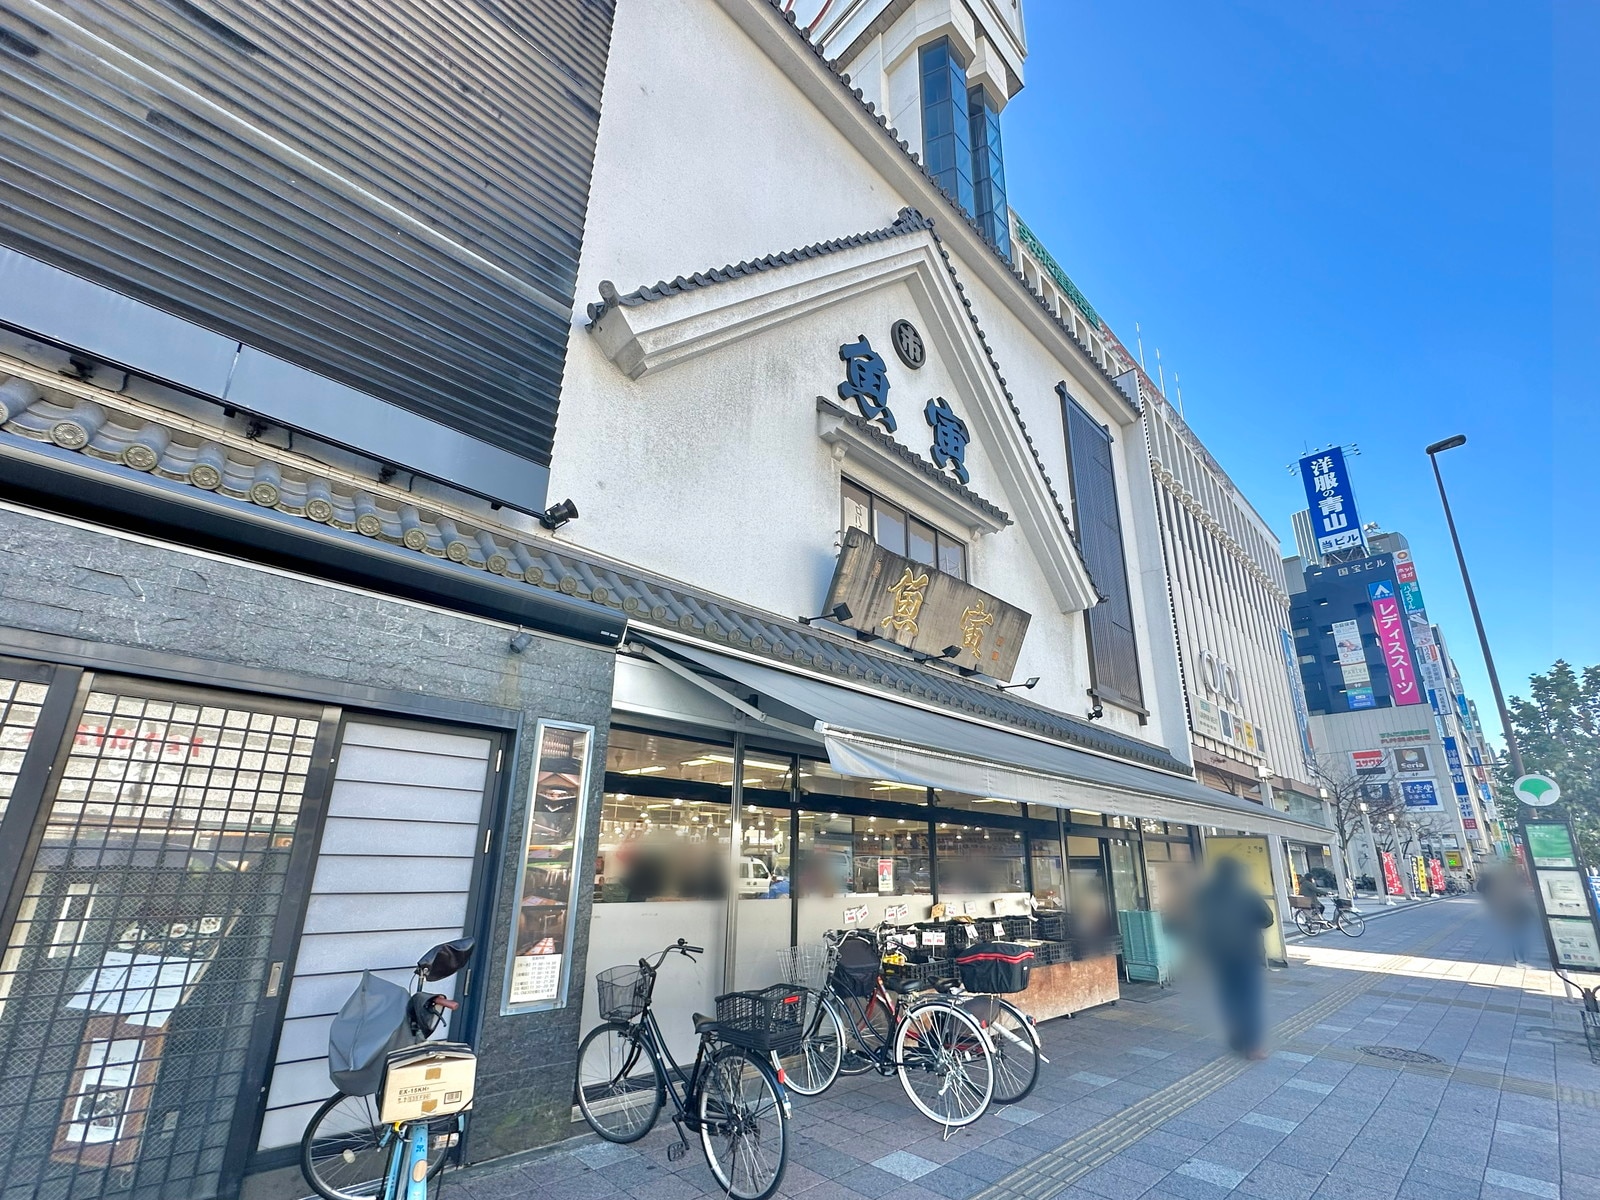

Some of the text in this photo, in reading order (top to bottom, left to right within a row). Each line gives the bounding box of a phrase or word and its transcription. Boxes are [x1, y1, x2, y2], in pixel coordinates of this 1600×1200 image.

[1310, 455, 1348, 532] 洋服の青山
[1321, 534, 1359, 549] 当ビル
[1380, 603, 1414, 695] レディススーツ
